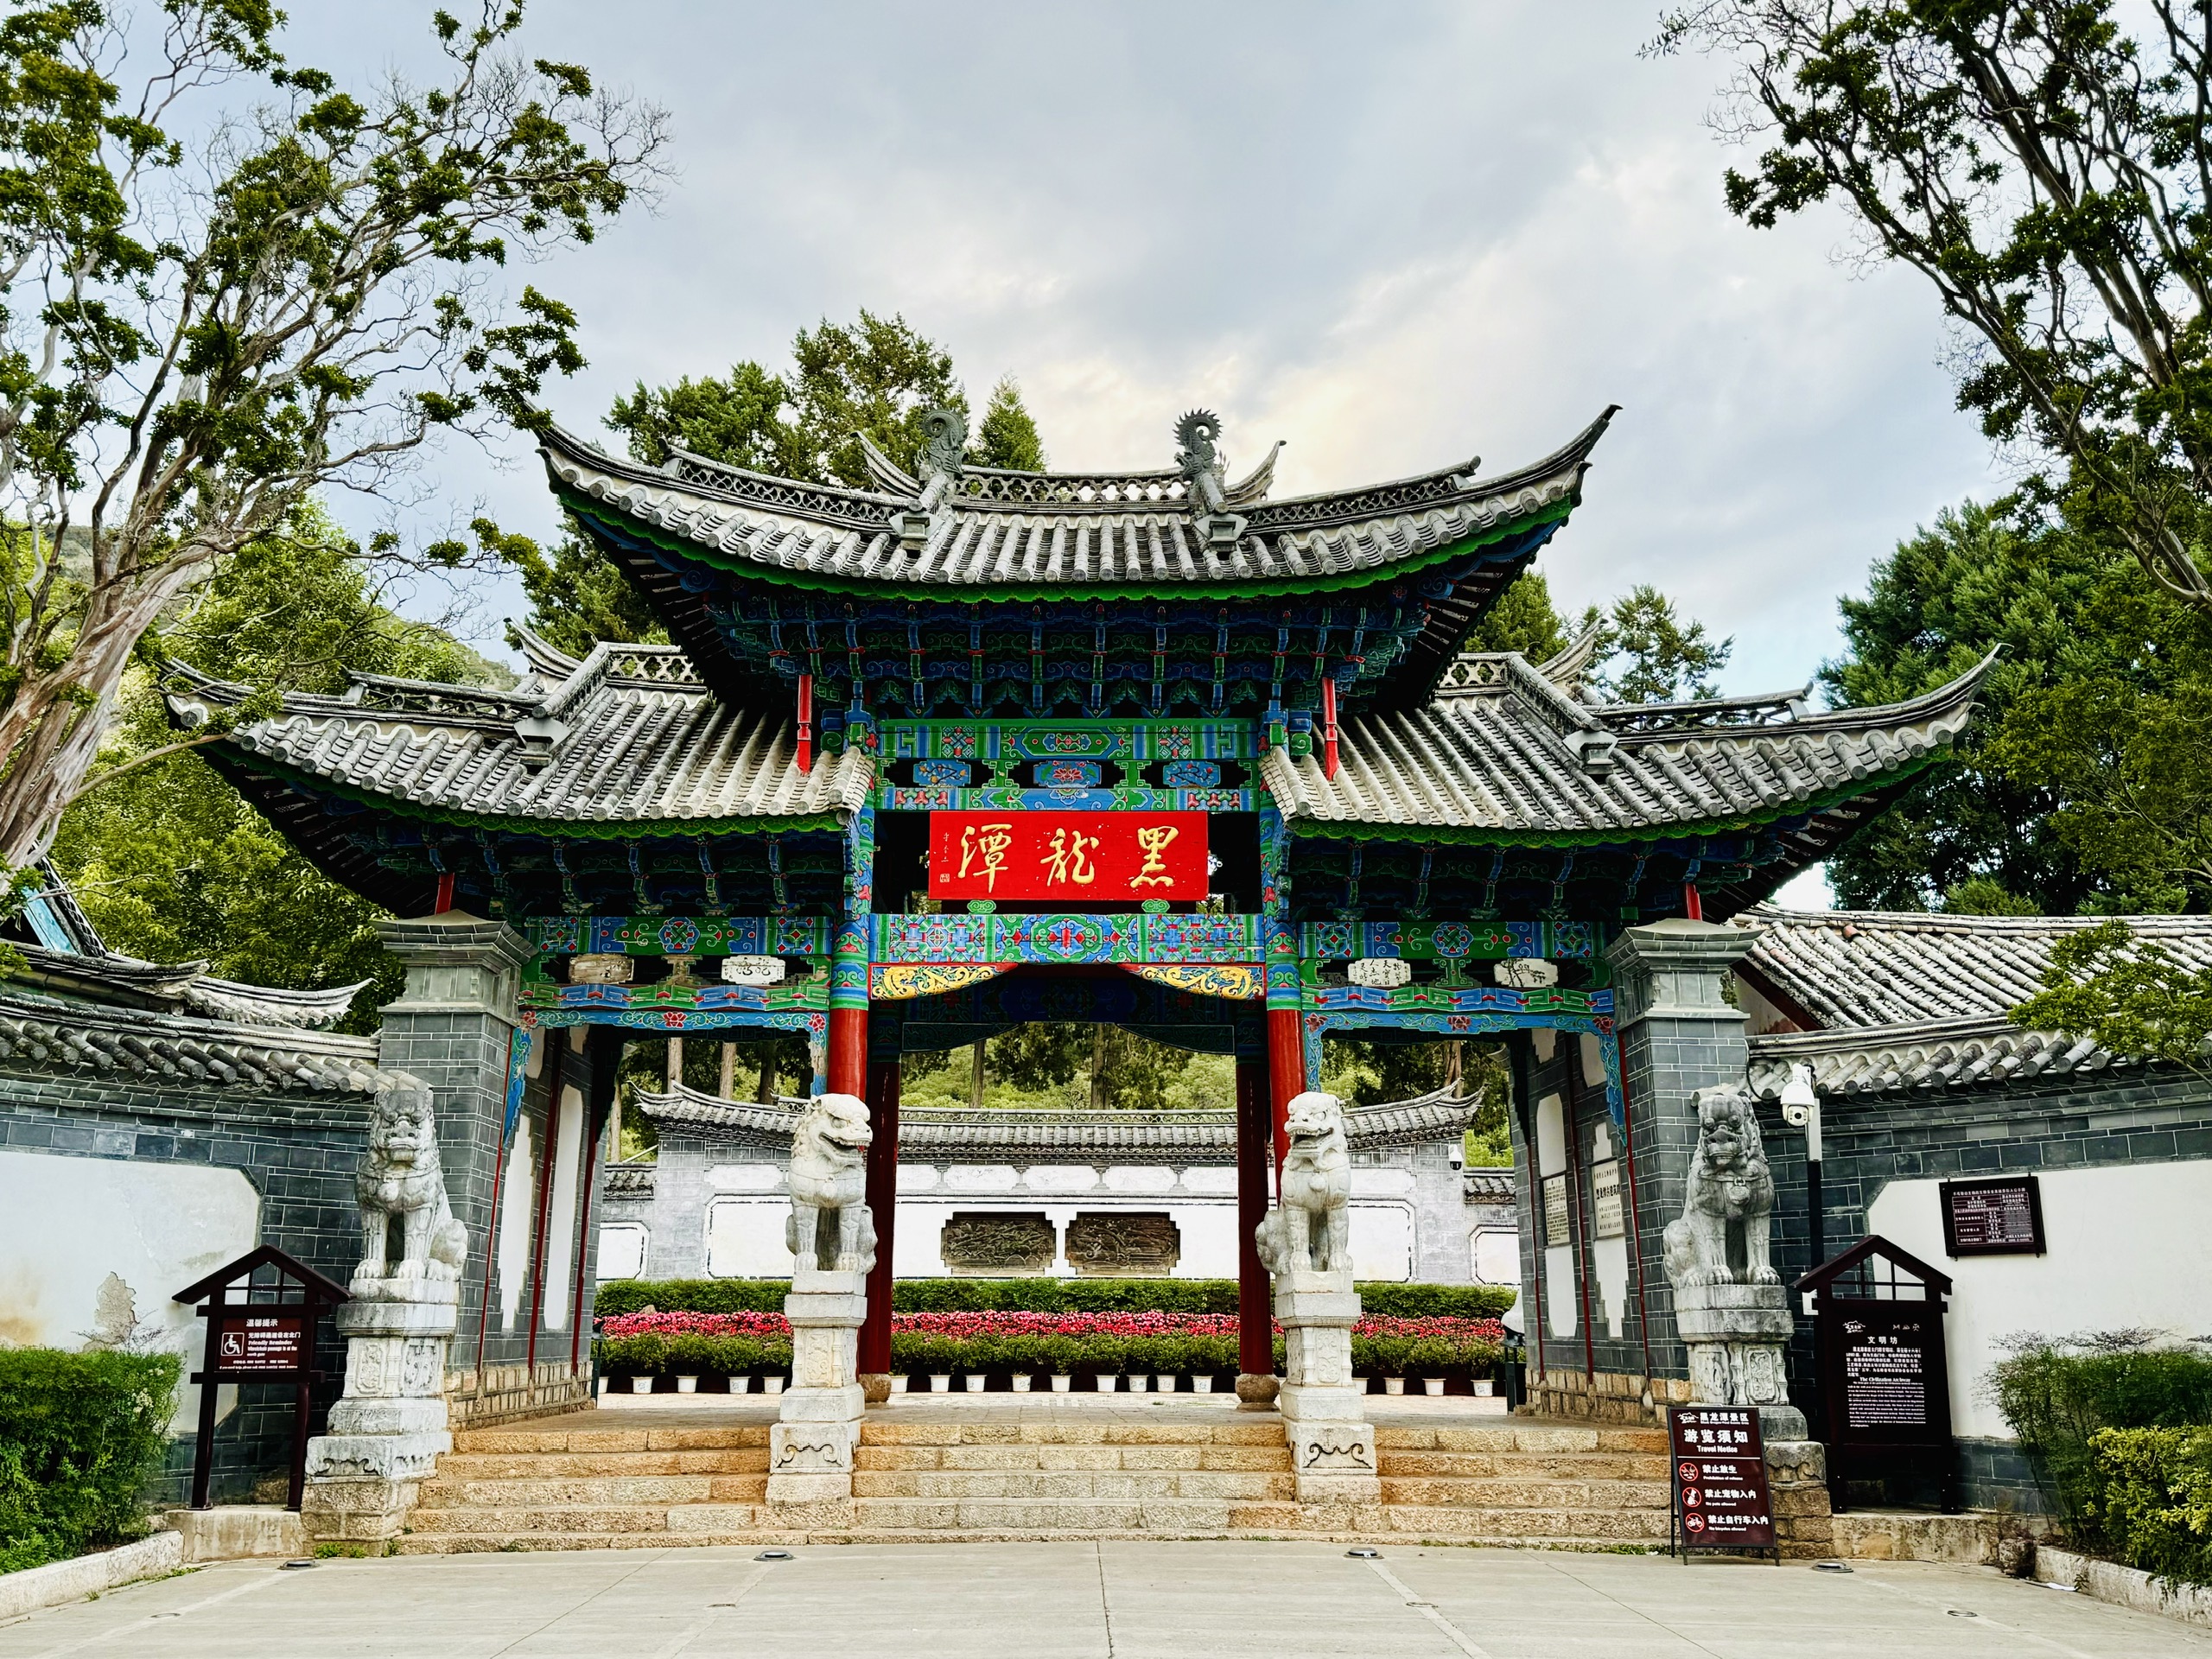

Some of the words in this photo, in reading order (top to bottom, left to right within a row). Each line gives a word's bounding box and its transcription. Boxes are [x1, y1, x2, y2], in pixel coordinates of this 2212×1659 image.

[245, 1319, 278, 1327] 温馨提示
[1867, 1336, 1897, 1344] 文明坊
[1700, 1412, 1749, 1421] 黑龙潭景区
[1684, 1428, 1749, 1444] 游览须知
[1702, 1465, 1738, 1474] 禁止放生
[1704, 1489, 1757, 1499] 禁止宠物入内
[1707, 1515, 1769, 1525] 禁止自行车入内
